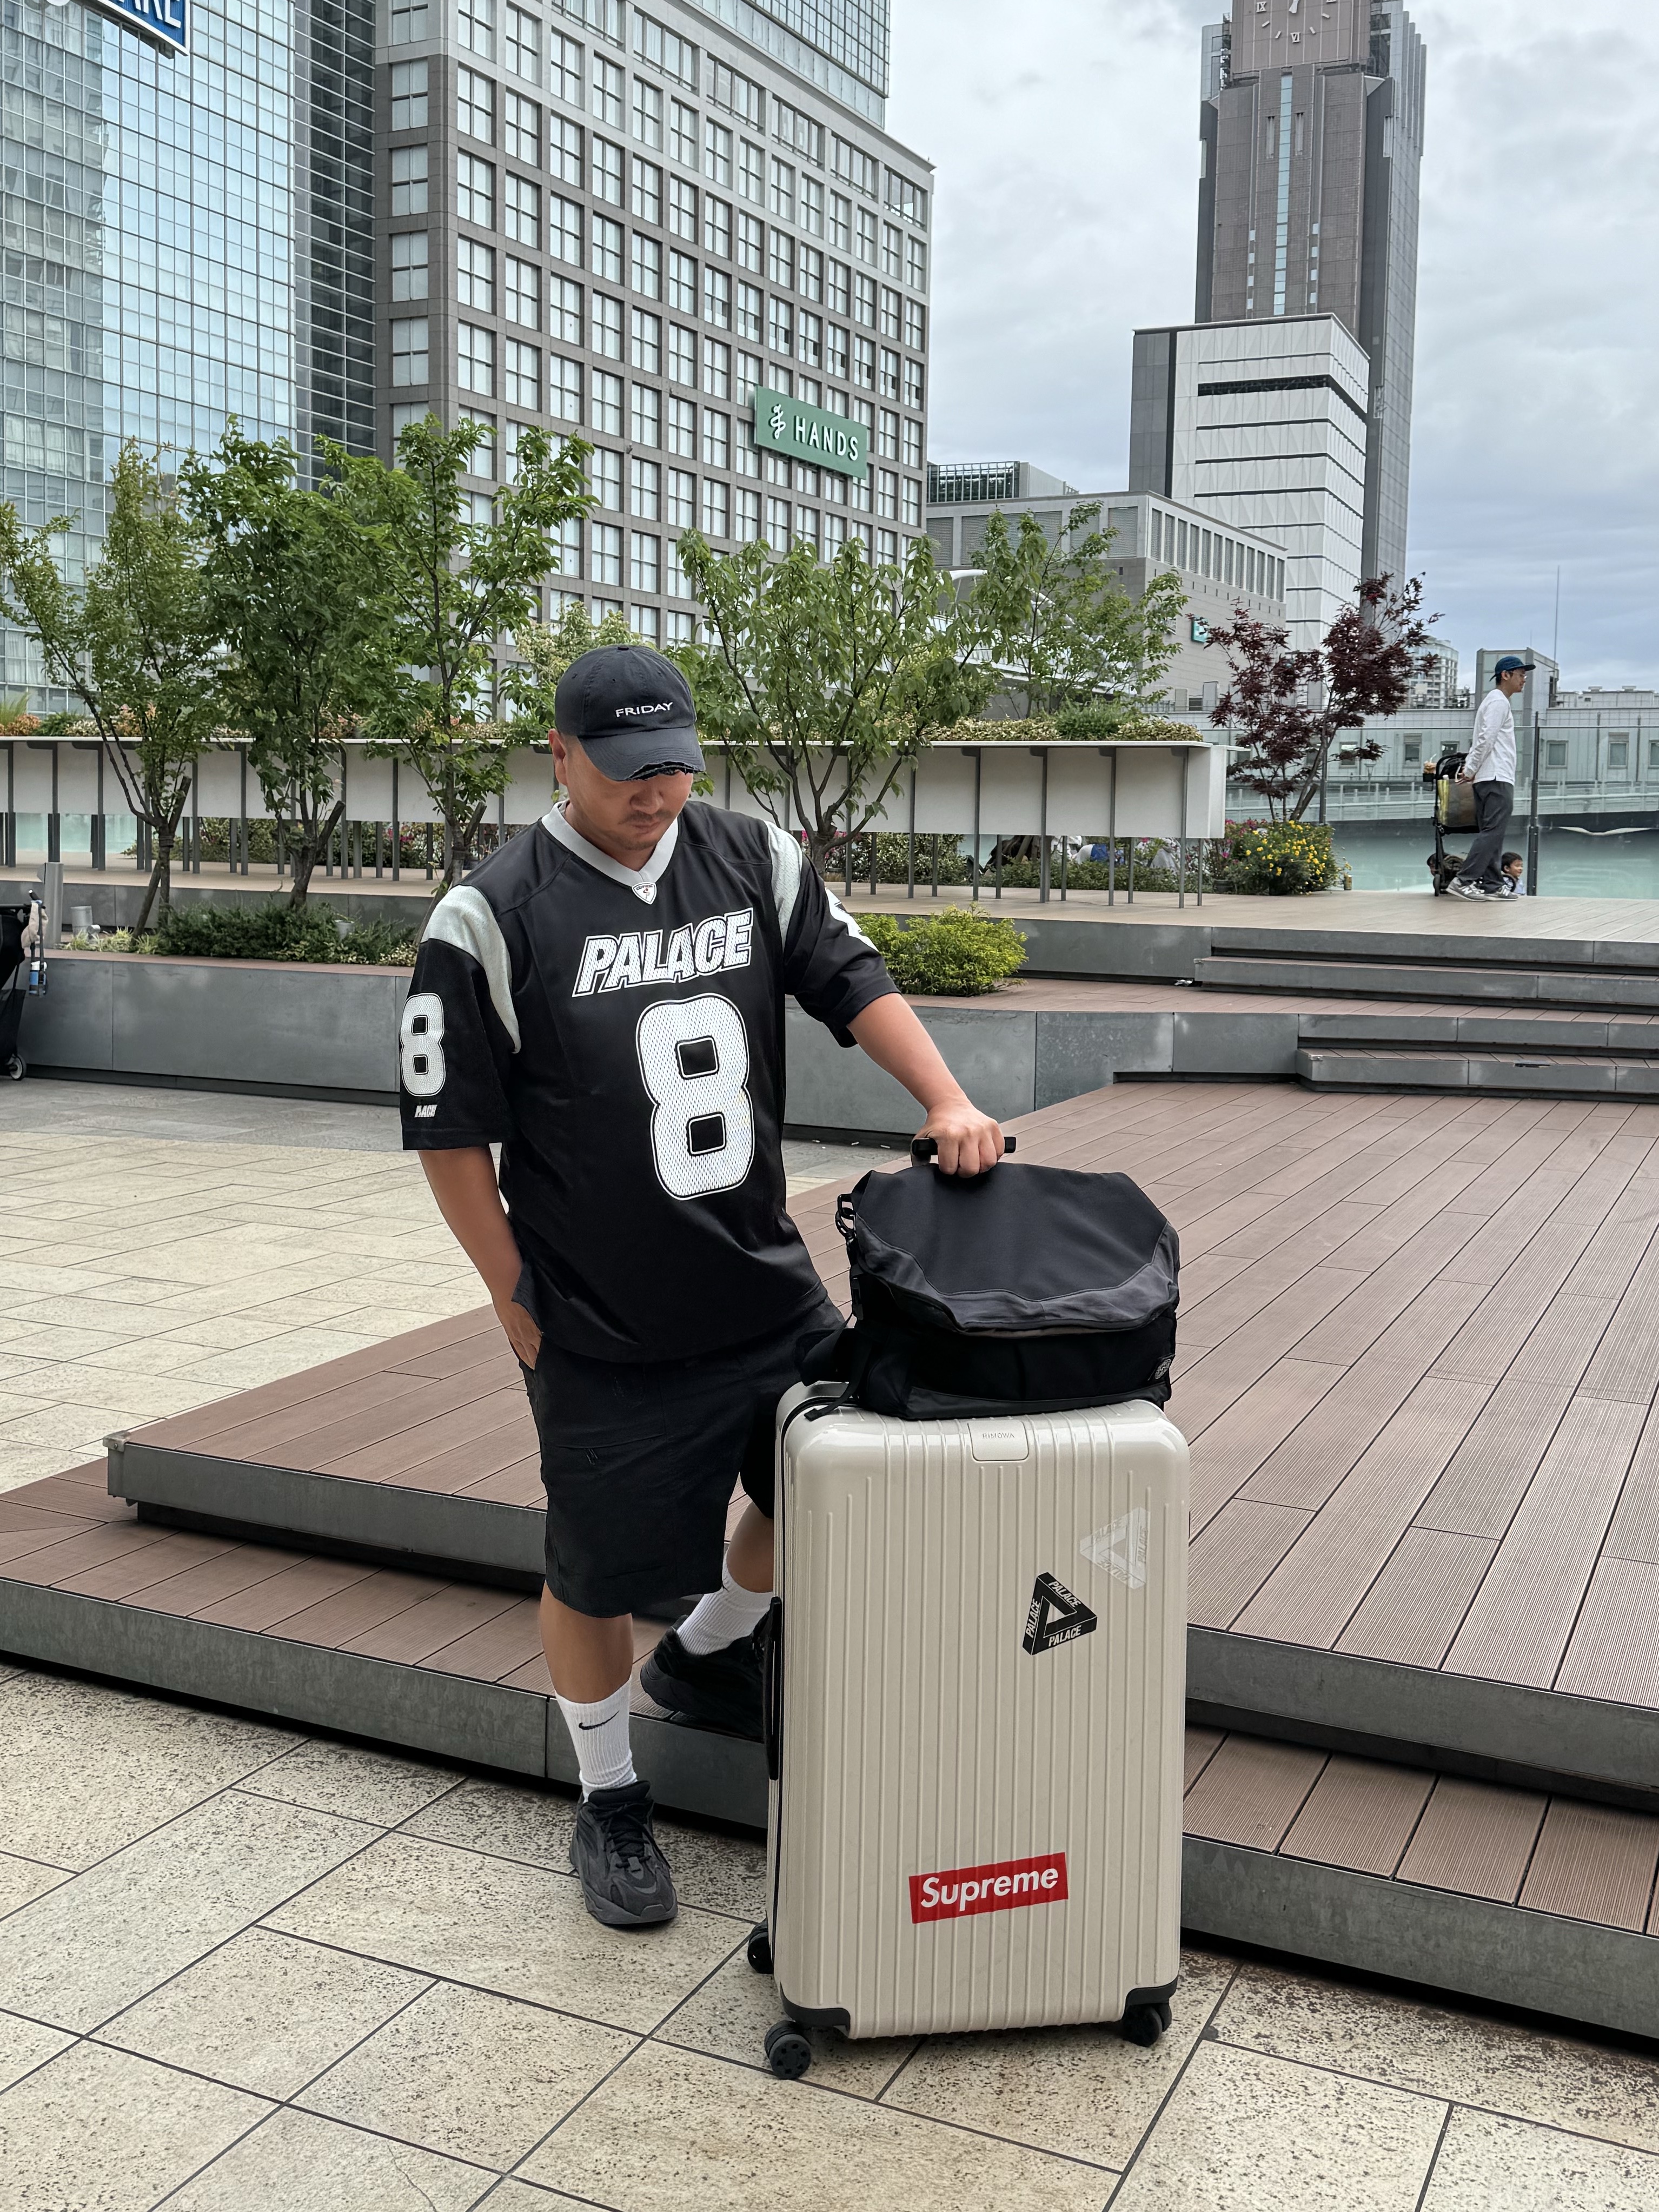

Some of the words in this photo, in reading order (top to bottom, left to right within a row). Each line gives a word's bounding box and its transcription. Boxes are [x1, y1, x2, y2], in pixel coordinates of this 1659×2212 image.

[1290, 32, 1300, 43] VI
[795, 415, 858, 461] HANDS
[615, 702, 673, 717] FRIDAY
[572, 908, 753, 997] PALACE
[399, 993, 446, 1097] 8
[636, 992, 755, 1201] 8
[1049, 1581, 1081, 1608] PALACE
[1025, 1599, 1041, 1638] PALACE
[1049, 1625, 1081, 1647] PALACE
[921, 1868, 1058, 1912] Supreme
